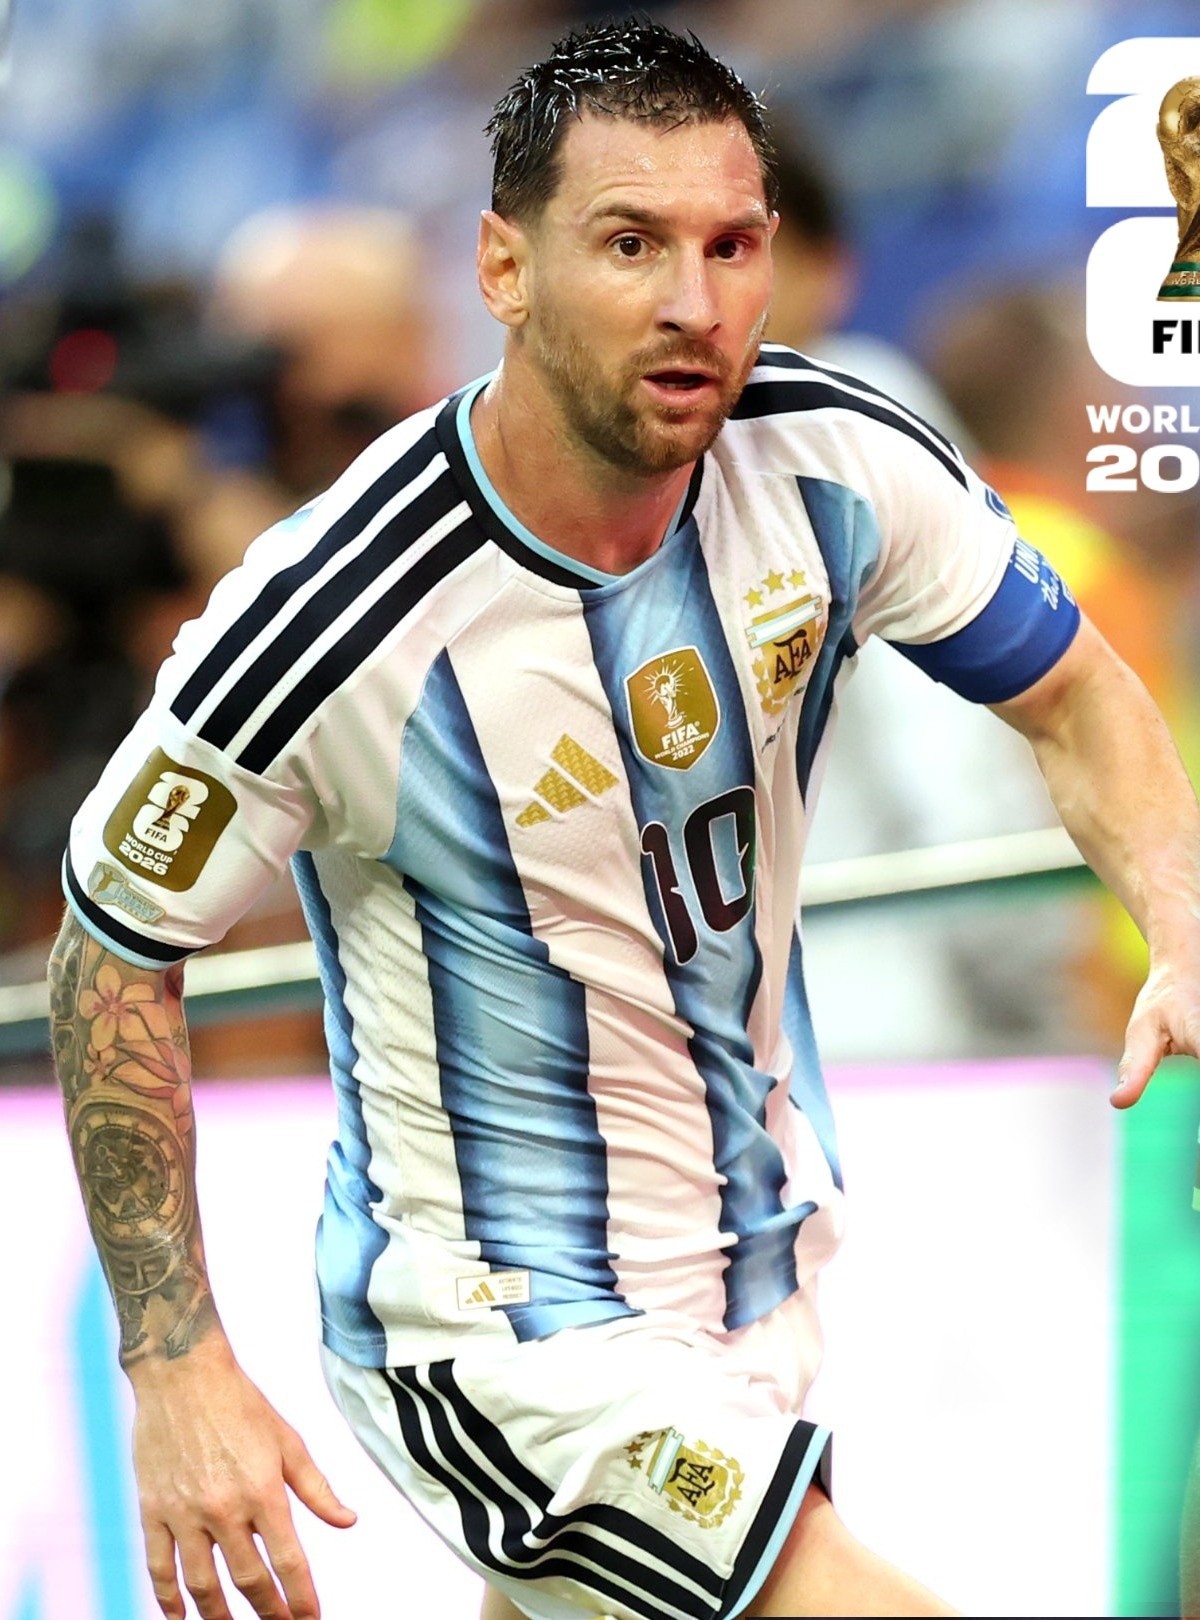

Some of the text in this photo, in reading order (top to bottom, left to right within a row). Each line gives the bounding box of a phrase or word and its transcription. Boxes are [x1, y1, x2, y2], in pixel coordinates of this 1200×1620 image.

[661, 723, 699, 750] FIFA
[672, 745, 695, 761] 2022
[125, 832, 174, 864] WORLD CUP
[144, 827, 168, 843] FIFA
[118, 841, 169, 876] 2026
[640, 785, 757, 966] 10
